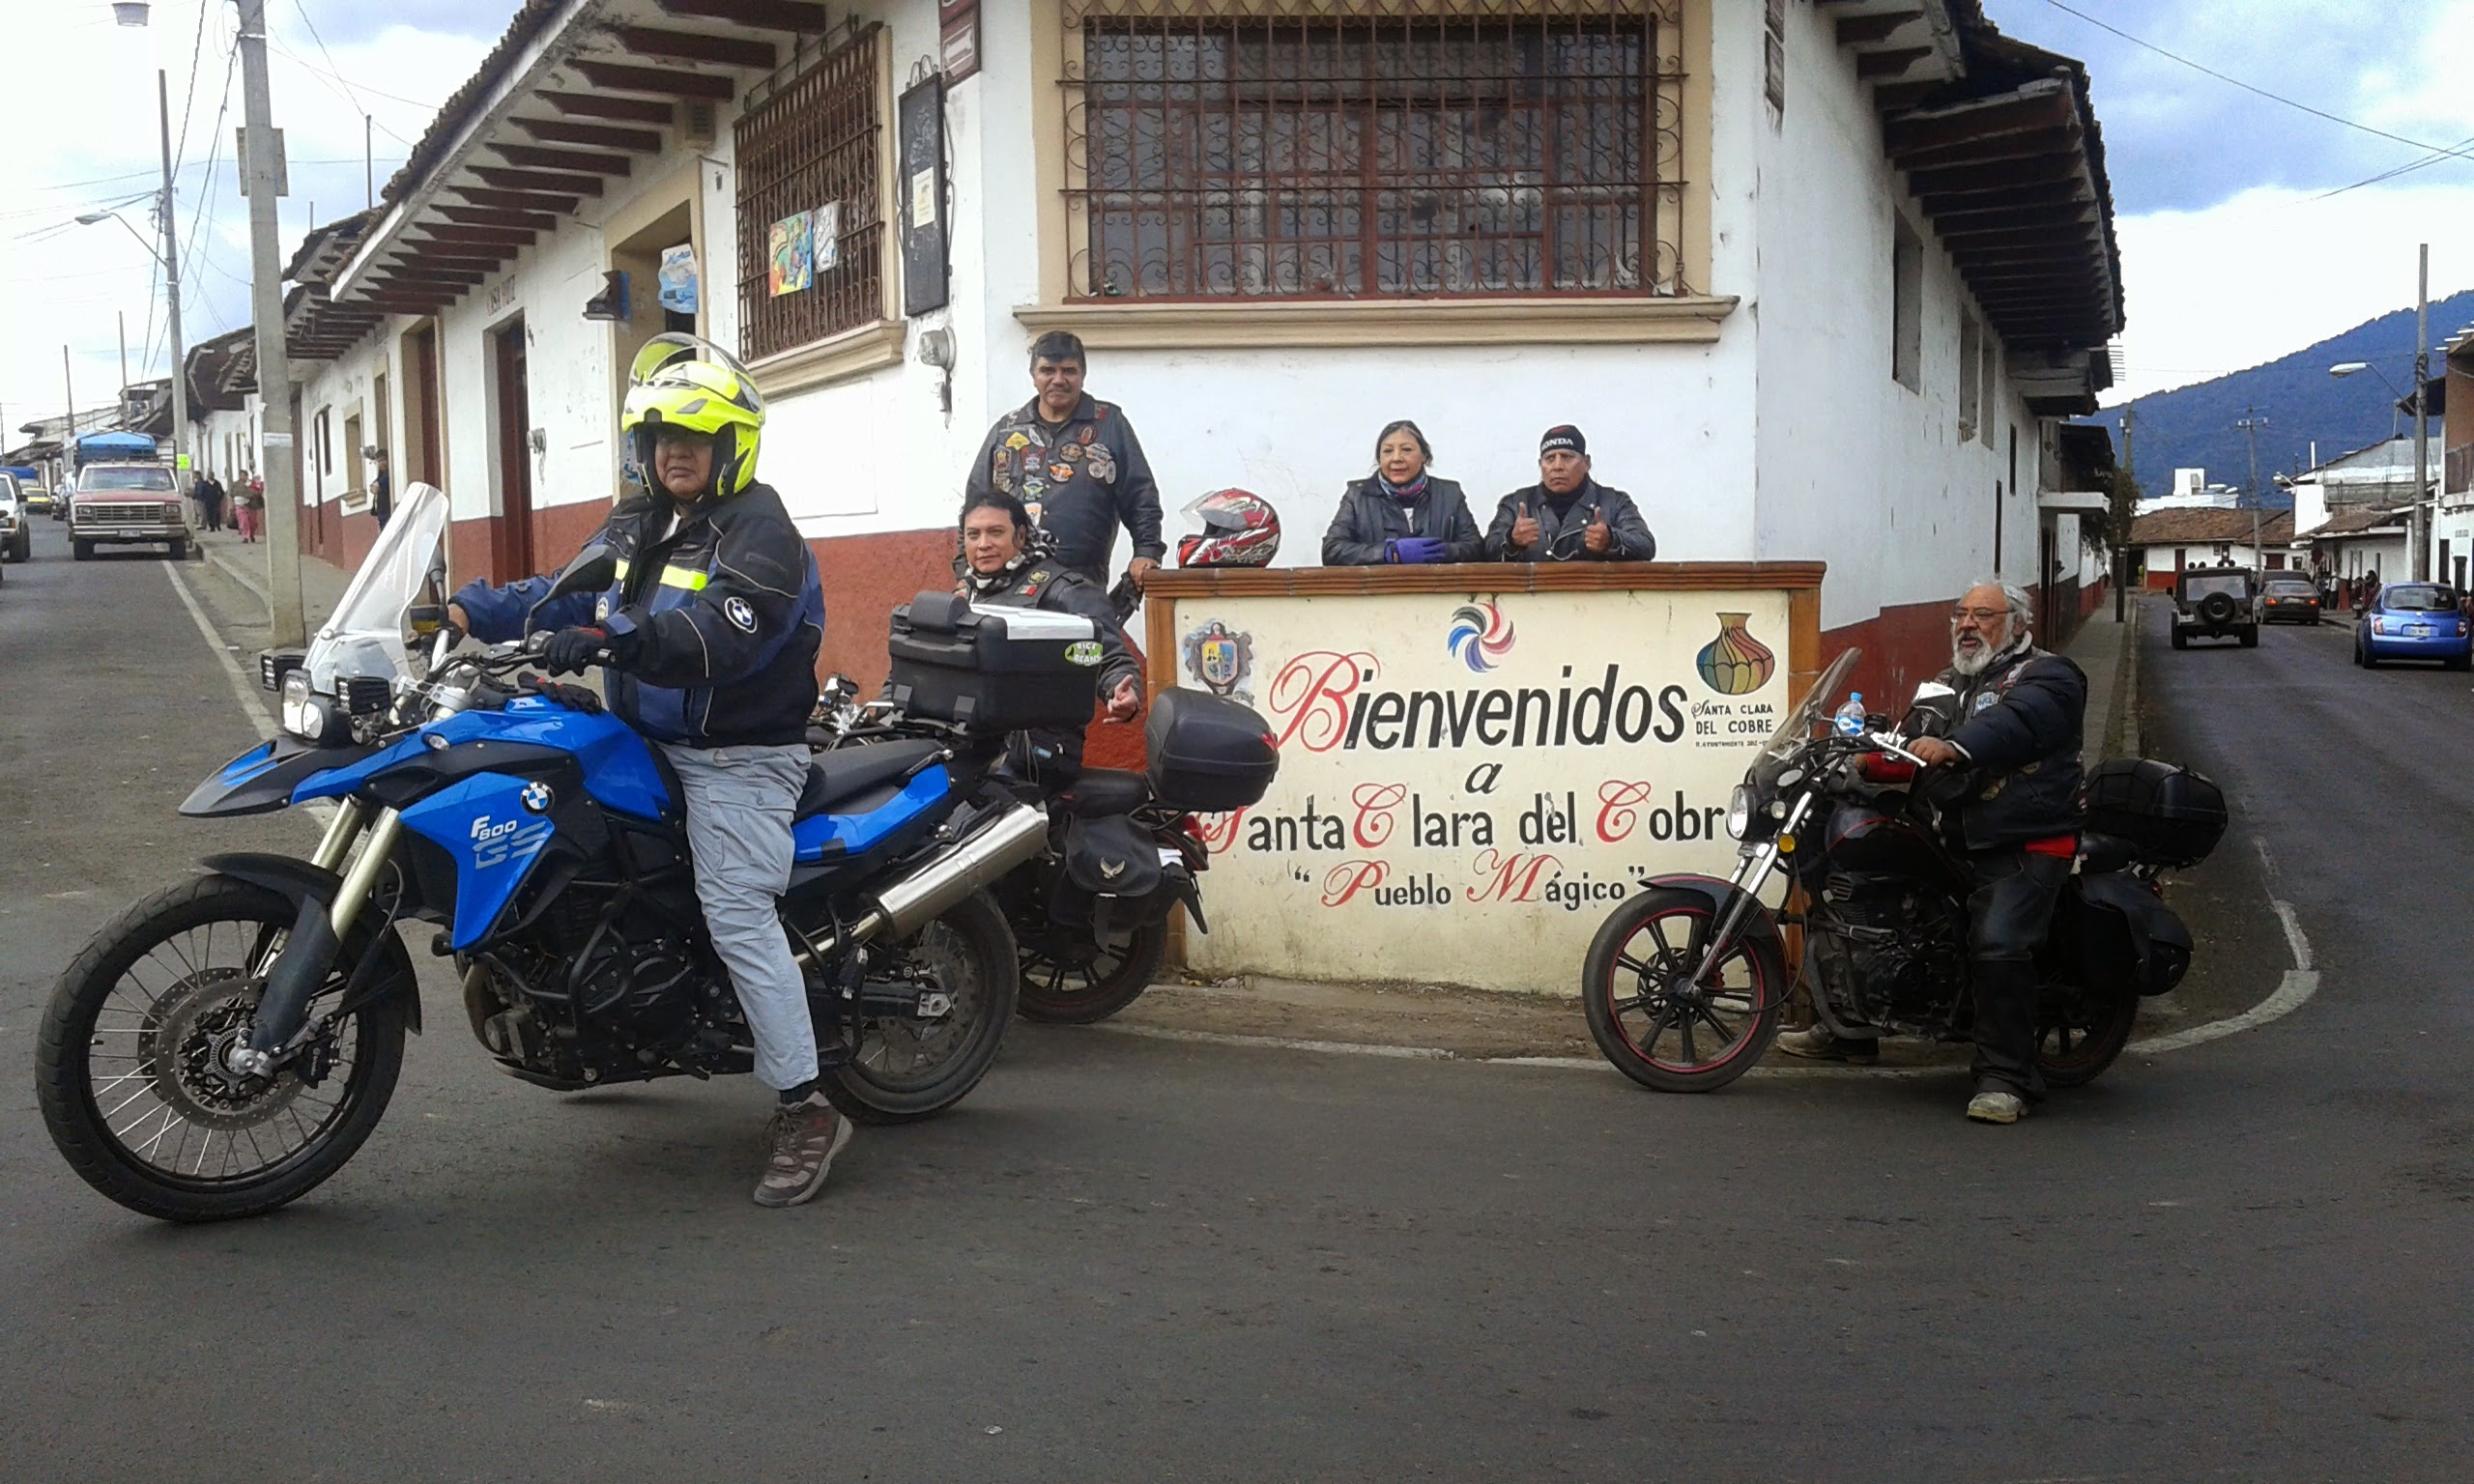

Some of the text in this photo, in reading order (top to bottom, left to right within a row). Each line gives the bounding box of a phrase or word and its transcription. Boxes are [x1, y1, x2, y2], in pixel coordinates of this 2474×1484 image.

[1269, 651, 1688, 753] Bienvenidos
[1691, 699, 1772, 718] SANTA CLARA
[1696, 719, 1772, 734] DEL COBRE
[1464, 762, 1503, 794] a
[470, 814, 517, 842] F800
[1196, 780, 1735, 854] Santa Clara del Cobr
[473, 821, 547, 869] GS
